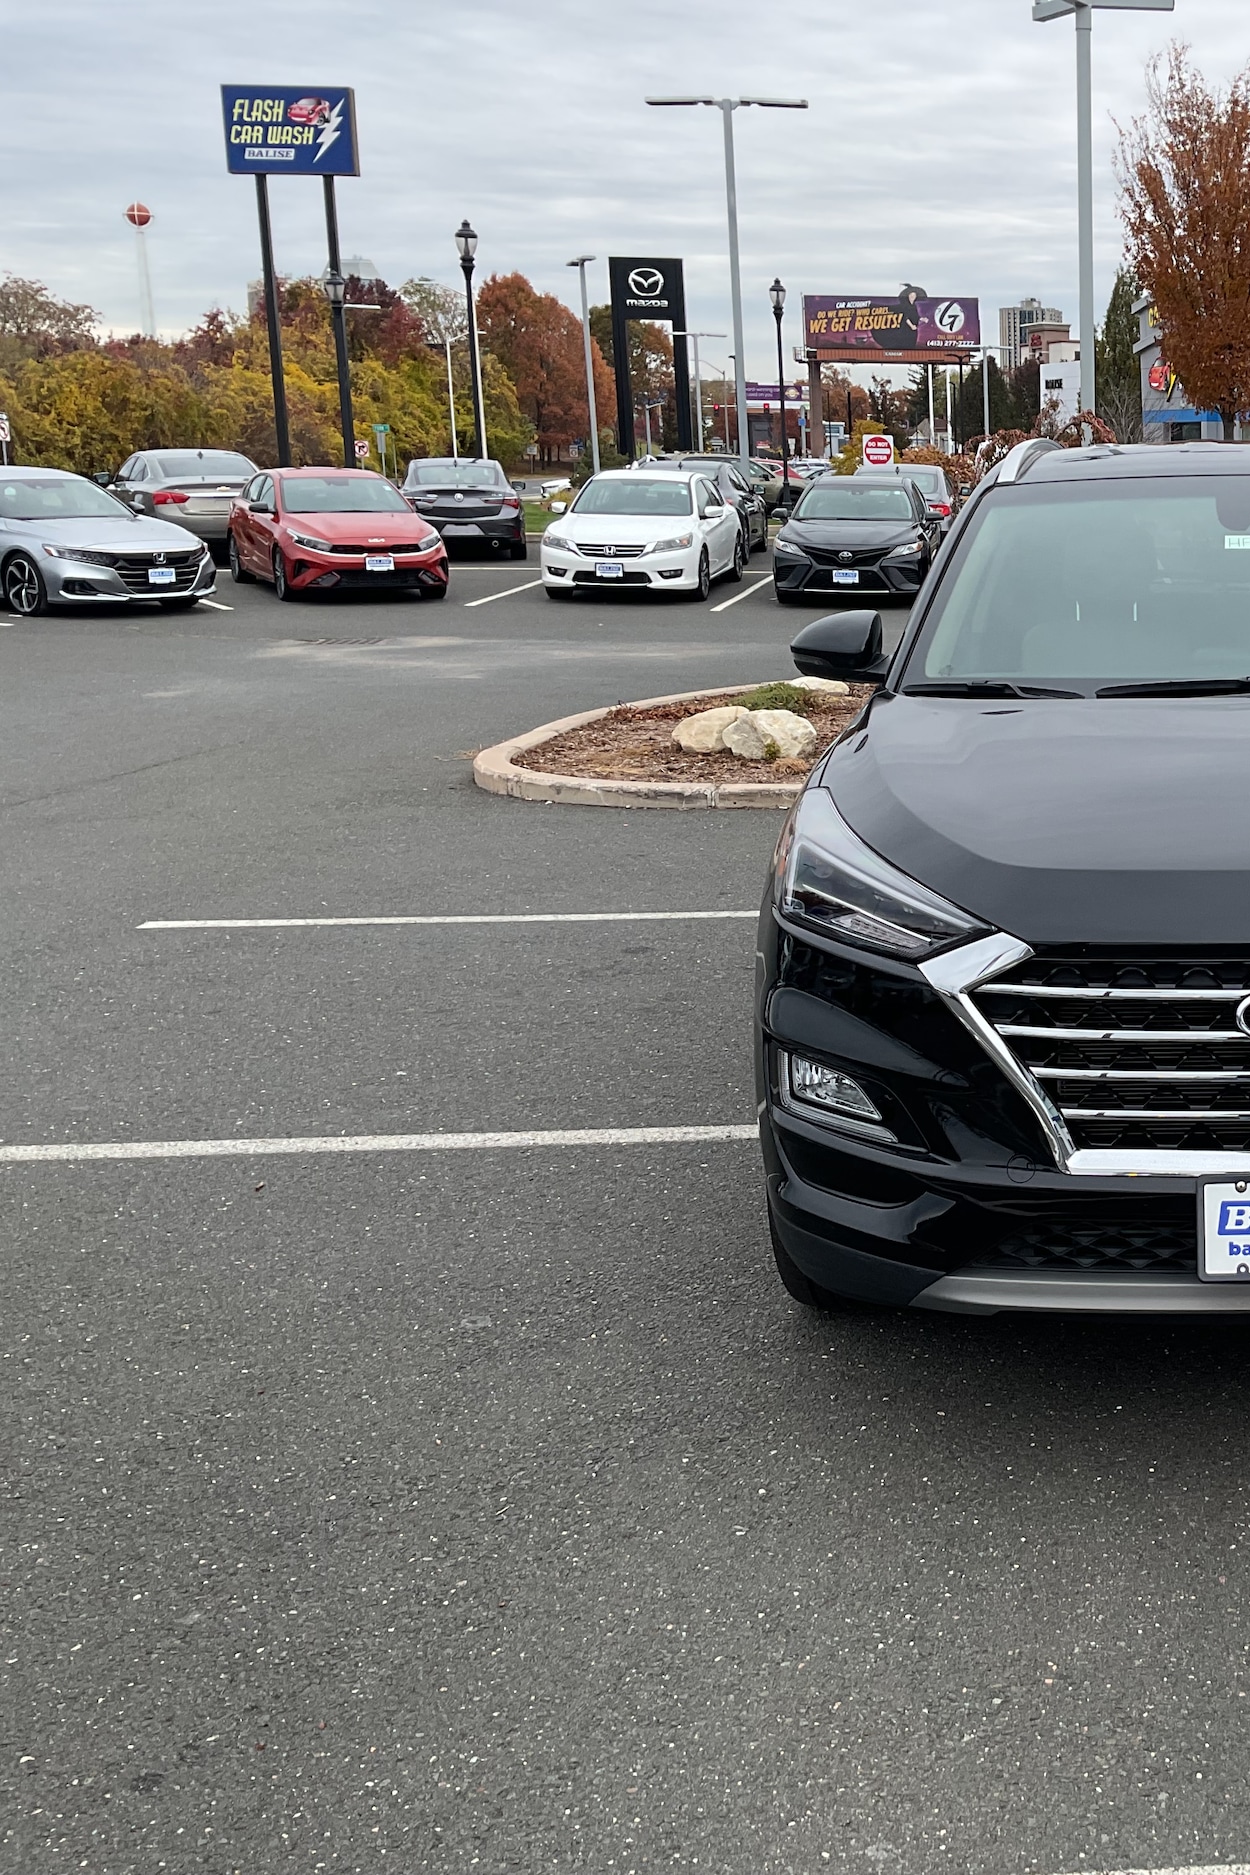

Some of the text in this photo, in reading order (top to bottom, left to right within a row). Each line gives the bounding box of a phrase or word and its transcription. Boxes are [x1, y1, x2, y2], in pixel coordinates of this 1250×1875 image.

[233, 98, 285, 122] FLASH
[230, 125, 314, 145] CAR WASH
[247, 149, 294, 158] BALISE
[626, 299, 669, 307] mazda
[810, 313, 904, 334] WE GET RESULTS!
